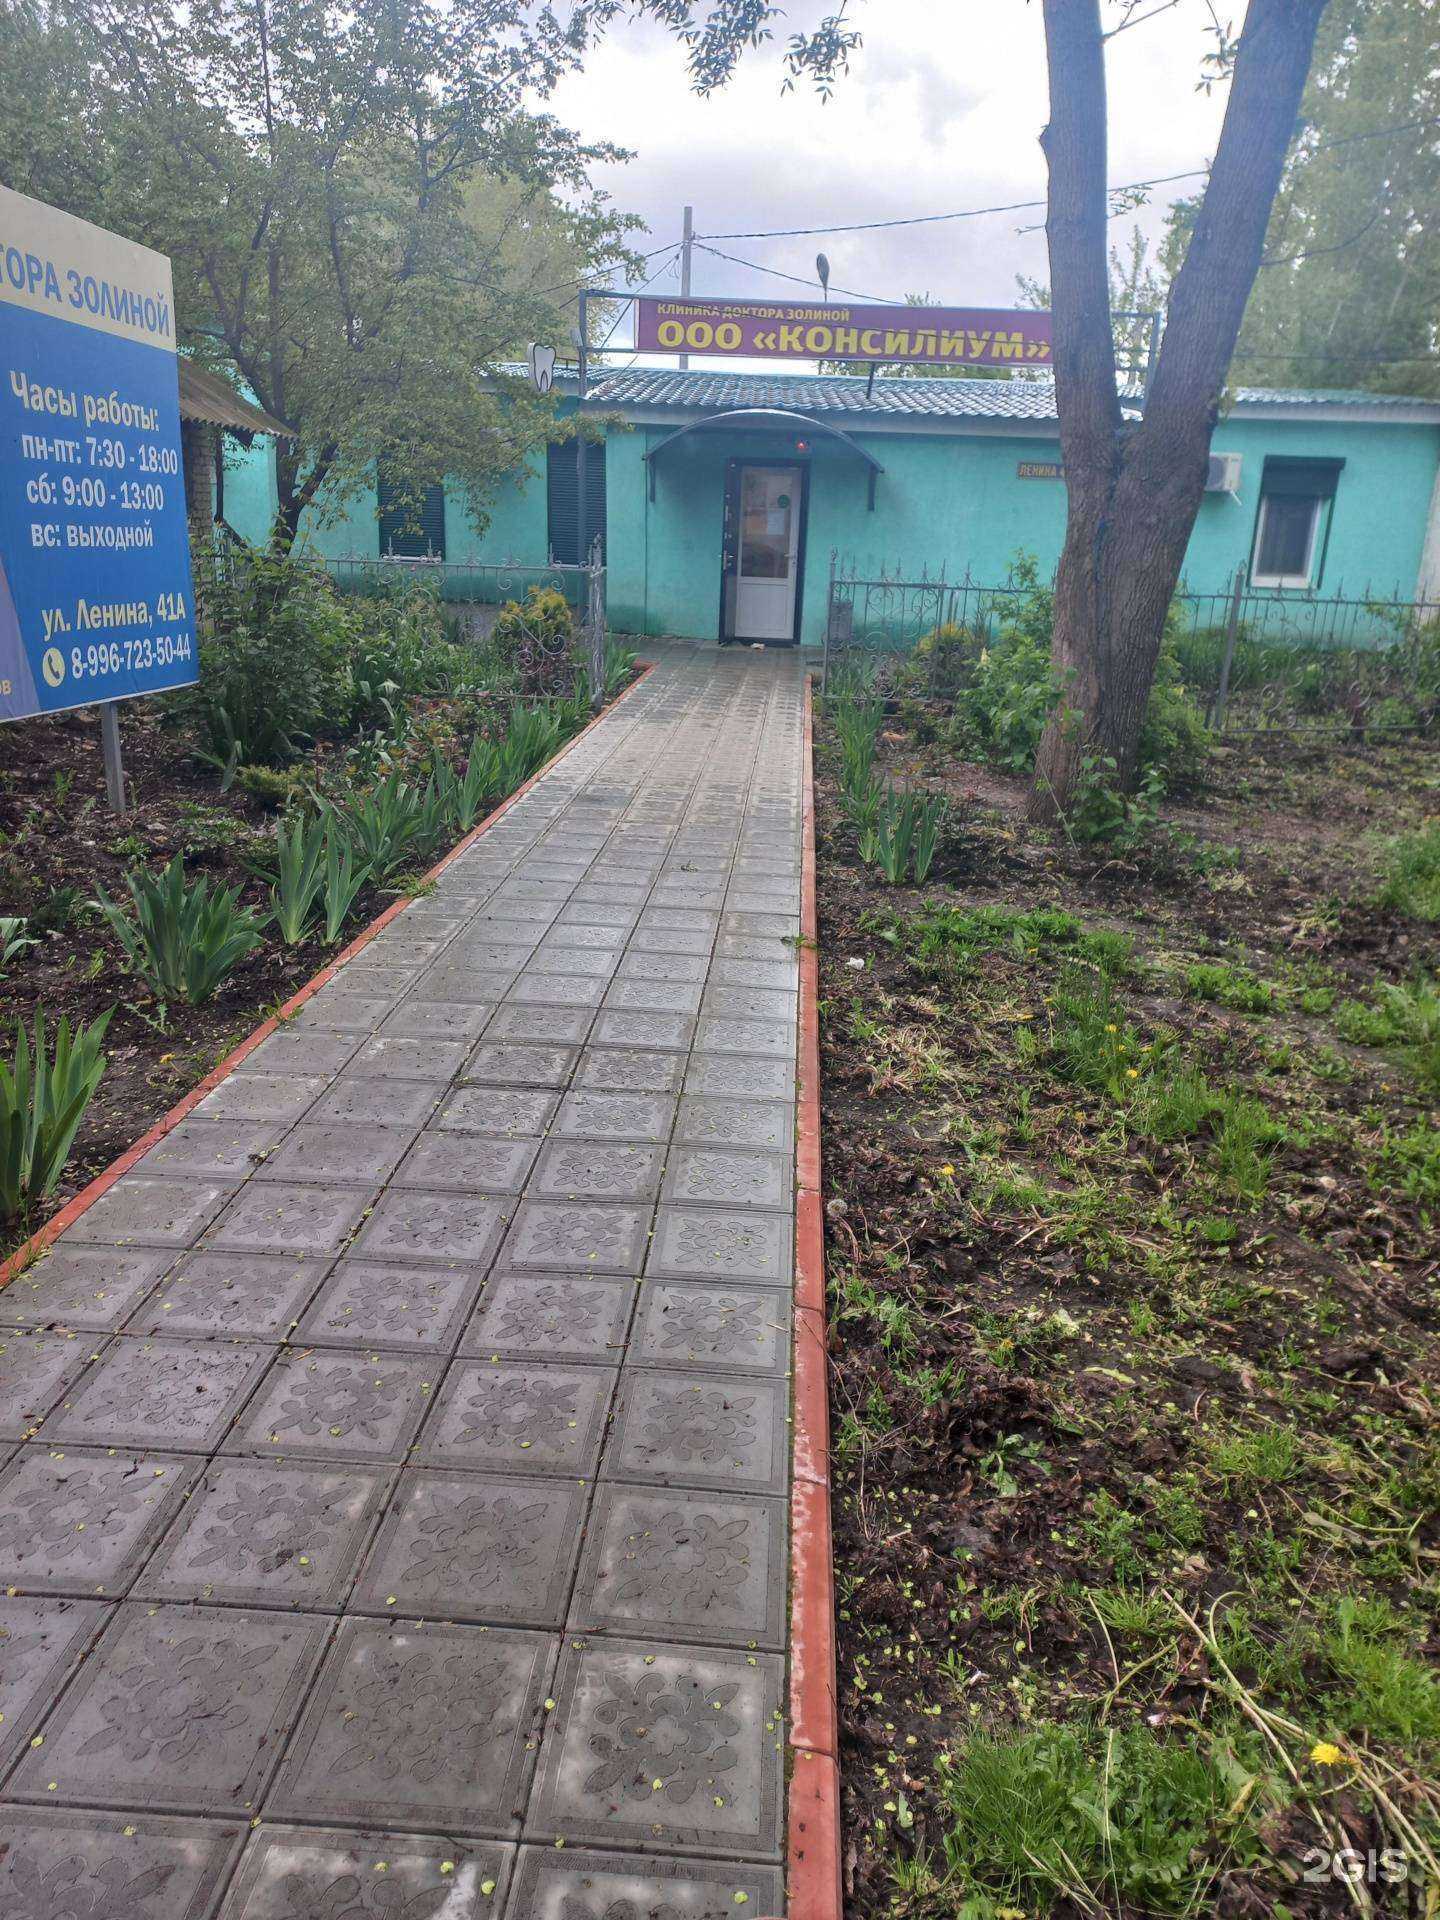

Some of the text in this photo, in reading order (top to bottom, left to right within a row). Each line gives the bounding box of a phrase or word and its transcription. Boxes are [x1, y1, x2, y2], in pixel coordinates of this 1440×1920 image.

[0, 243, 170, 338] ОРА ЗОЛИНОЙ
[656, 303, 851, 322] КЛИНИКА ДОКТОРА ЗОЛИНОЙ
[656, 320, 1052, 359] ООО «КОНСИЛИУМ»
[10, 369, 160, 432] Часы работы:
[21, 433, 82, 465] пн-пт:
[85, 436, 126, 470] 7:30
[138, 444, 178, 475] 18:00
[1018, 464, 1057, 477] ЛЕНИНА
[26, 472, 58, 505] сб:
[61, 476, 106, 508] 9:00
[120, 480, 165, 511] 13:00
[31, 519, 154, 551] вс: выходной
[41, 592, 186, 642] ул. Ленина, 41А
[71, 633, 192, 680] 8-996-723-50-44
